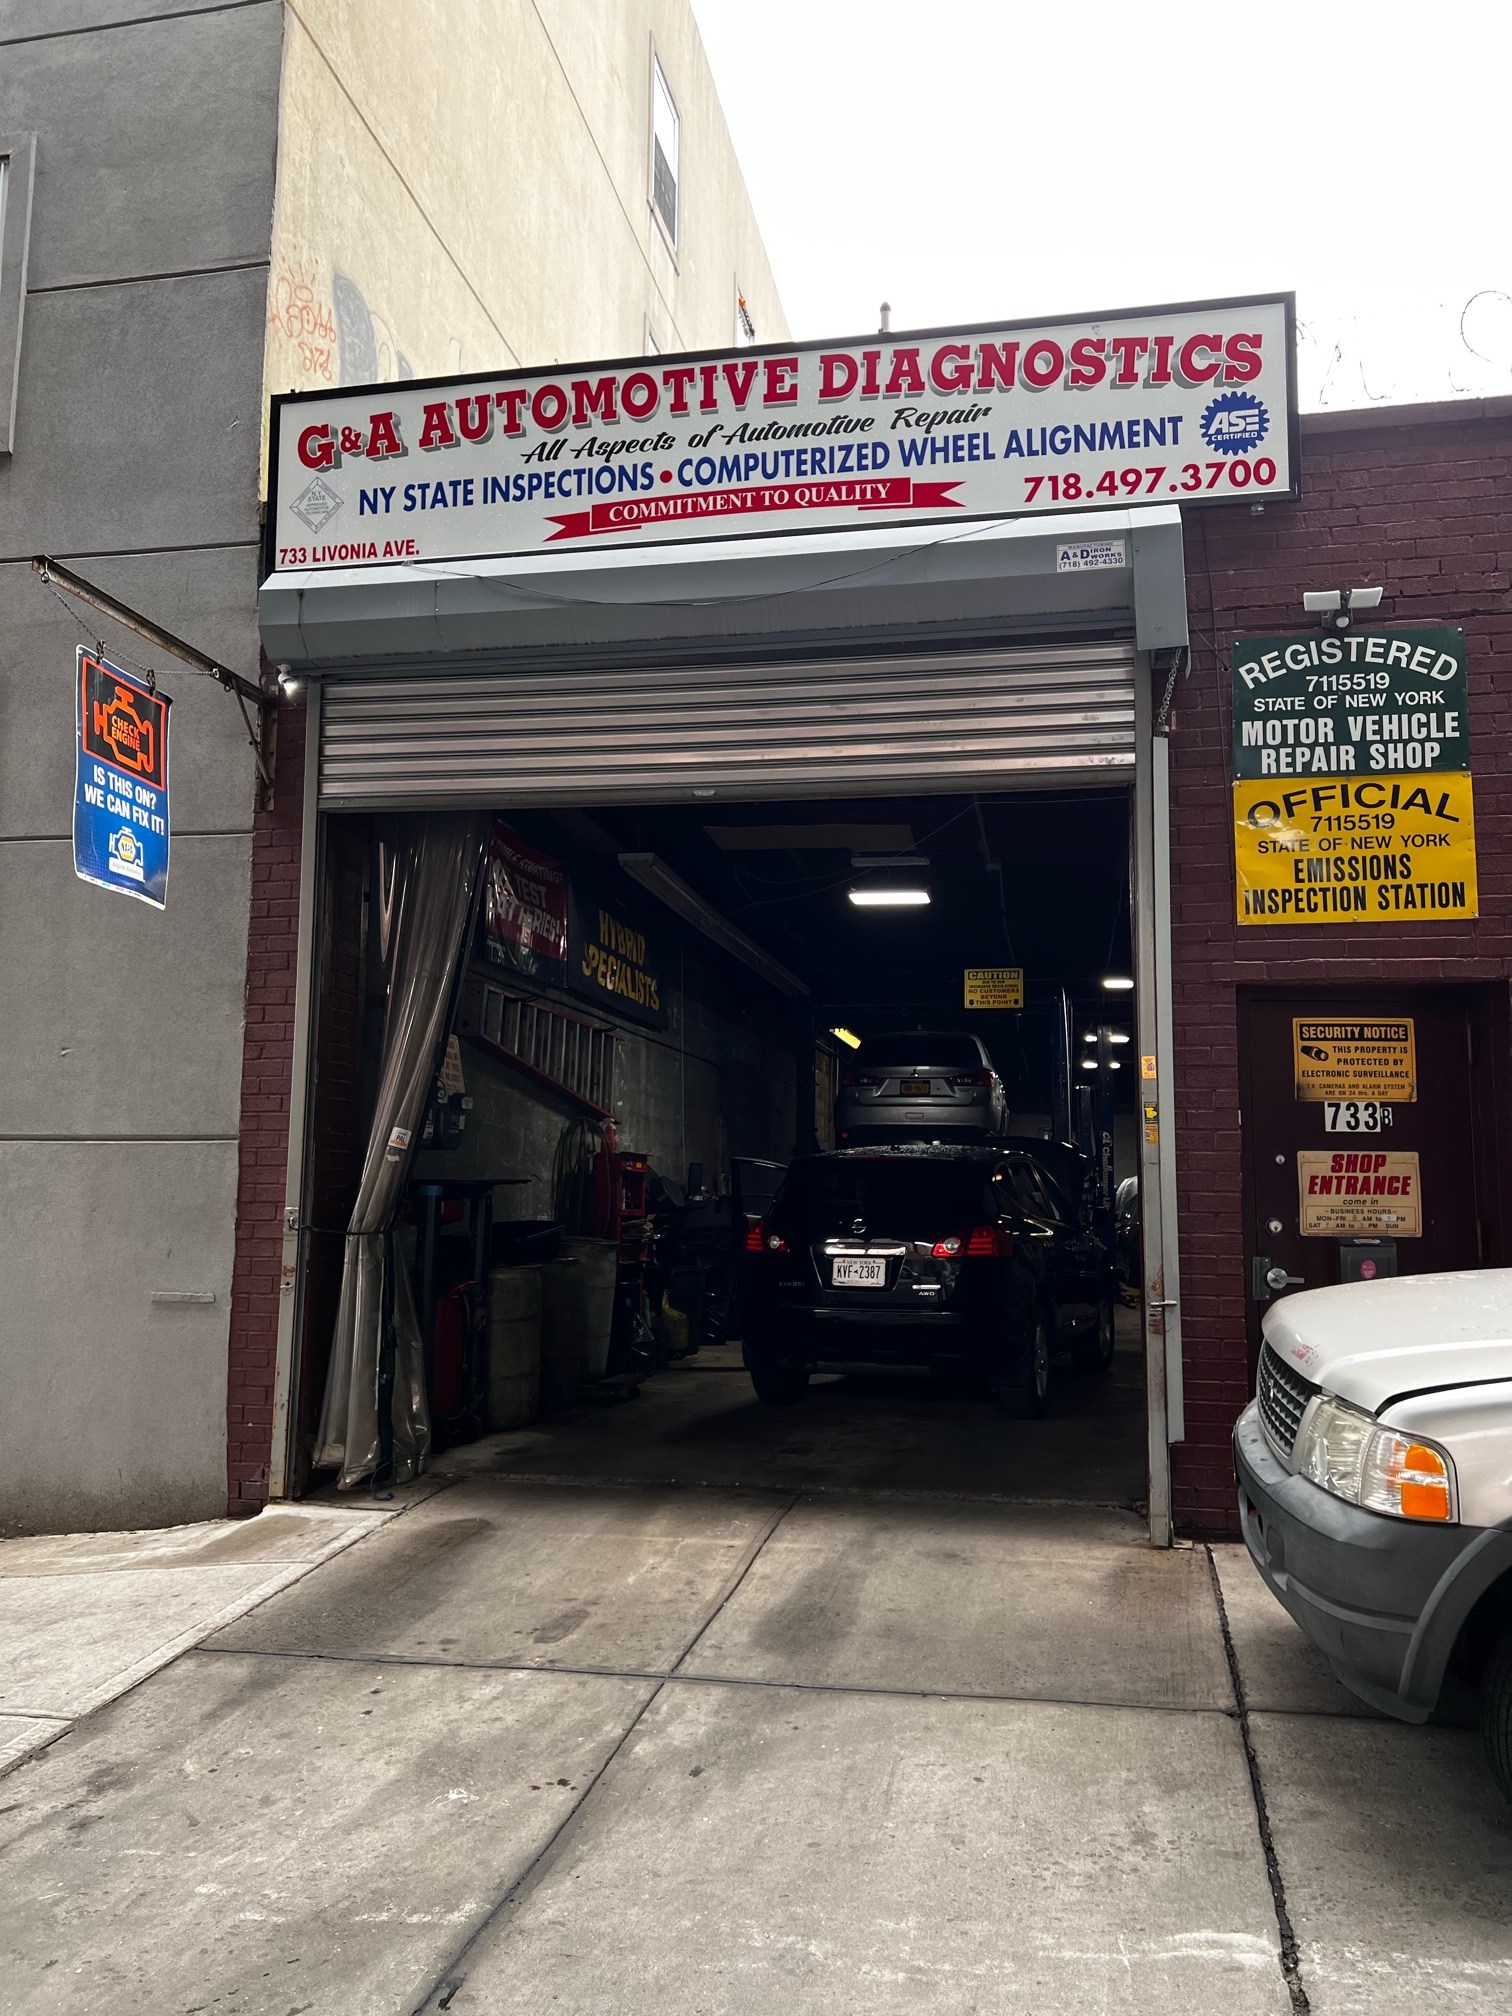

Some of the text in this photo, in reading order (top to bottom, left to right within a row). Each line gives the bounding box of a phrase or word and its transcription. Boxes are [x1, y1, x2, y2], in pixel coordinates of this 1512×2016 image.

[297, 333, 1264, 471] G&A AUTOMOTIVE DIAGNOSTICS
[520, 403, 994, 464] All Aspects of Automotive Repair
[1207, 408, 1259, 435] ASE
[1211, 431, 1258, 441] CERTIFIED
[359, 488, 396, 516] NY
[403, 478, 475, 511] STATE
[482, 462, 655, 505] INSPECTIONS
[677, 441, 891, 487] COMPUTERIZED
[899, 432, 996, 468] WHEEL
[1003, 416, 1184, 459] ALIGNMENT
[1023, 457, 1277, 503] 718.497.3700
[608, 483, 892, 522] COMMITMENT TO QUALITY
[279, 538, 420, 565] 733 LIVONIA AVE.
[1060, 557, 1123, 570] (718) 492-4330
[1061, 551, 1071, 560] A
[1081, 549, 1090, 559] D
[1238, 637, 1458, 690] REGISTERED
[1305, 672, 1390, 693] 7115519
[1253, 690, 1446, 712] STATE OF NEW YORK
[111, 714, 140, 740] CHECK
[111, 726, 141, 752] ENGINE
[1241, 711, 1460, 747] MOTOR VEHICLE
[1261, 741, 1441, 774] REPAIR SHOP
[93, 764, 157, 811] IS THIS ON?
[84, 783, 165, 836] WE CAN FIX IT!
[1247, 782, 1460, 829] OFFICIAL
[1310, 812, 1396, 833] 7115519
[1257, 833, 1451, 855] STATE OF NEW YORK
[1293, 854, 1412, 884] EMISSIONS
[1244, 881, 1466, 916] INSPECTION STATION
[598, 909, 646, 966] HYBRID
[581, 940, 661, 1011] SPECIALISTS
[969, 971, 1019, 980] CAUTION
[1301, 1026, 1407, 1039] SECURITY NOTICE
[1332, 1045, 1408, 1054] THIS PROPERTY IS
[1337, 1058, 1404, 1066] PROTECTED BY
[1301, 1069, 1410, 1079] ELECTRONIC SURVEILLANCE
[1326, 1102, 1380, 1131] 733
[1330, 1153, 1387, 1174] SHOP
[1308, 1175, 1411, 1196] ENTRANCE
[1370, 1198, 1379, 1206] in
